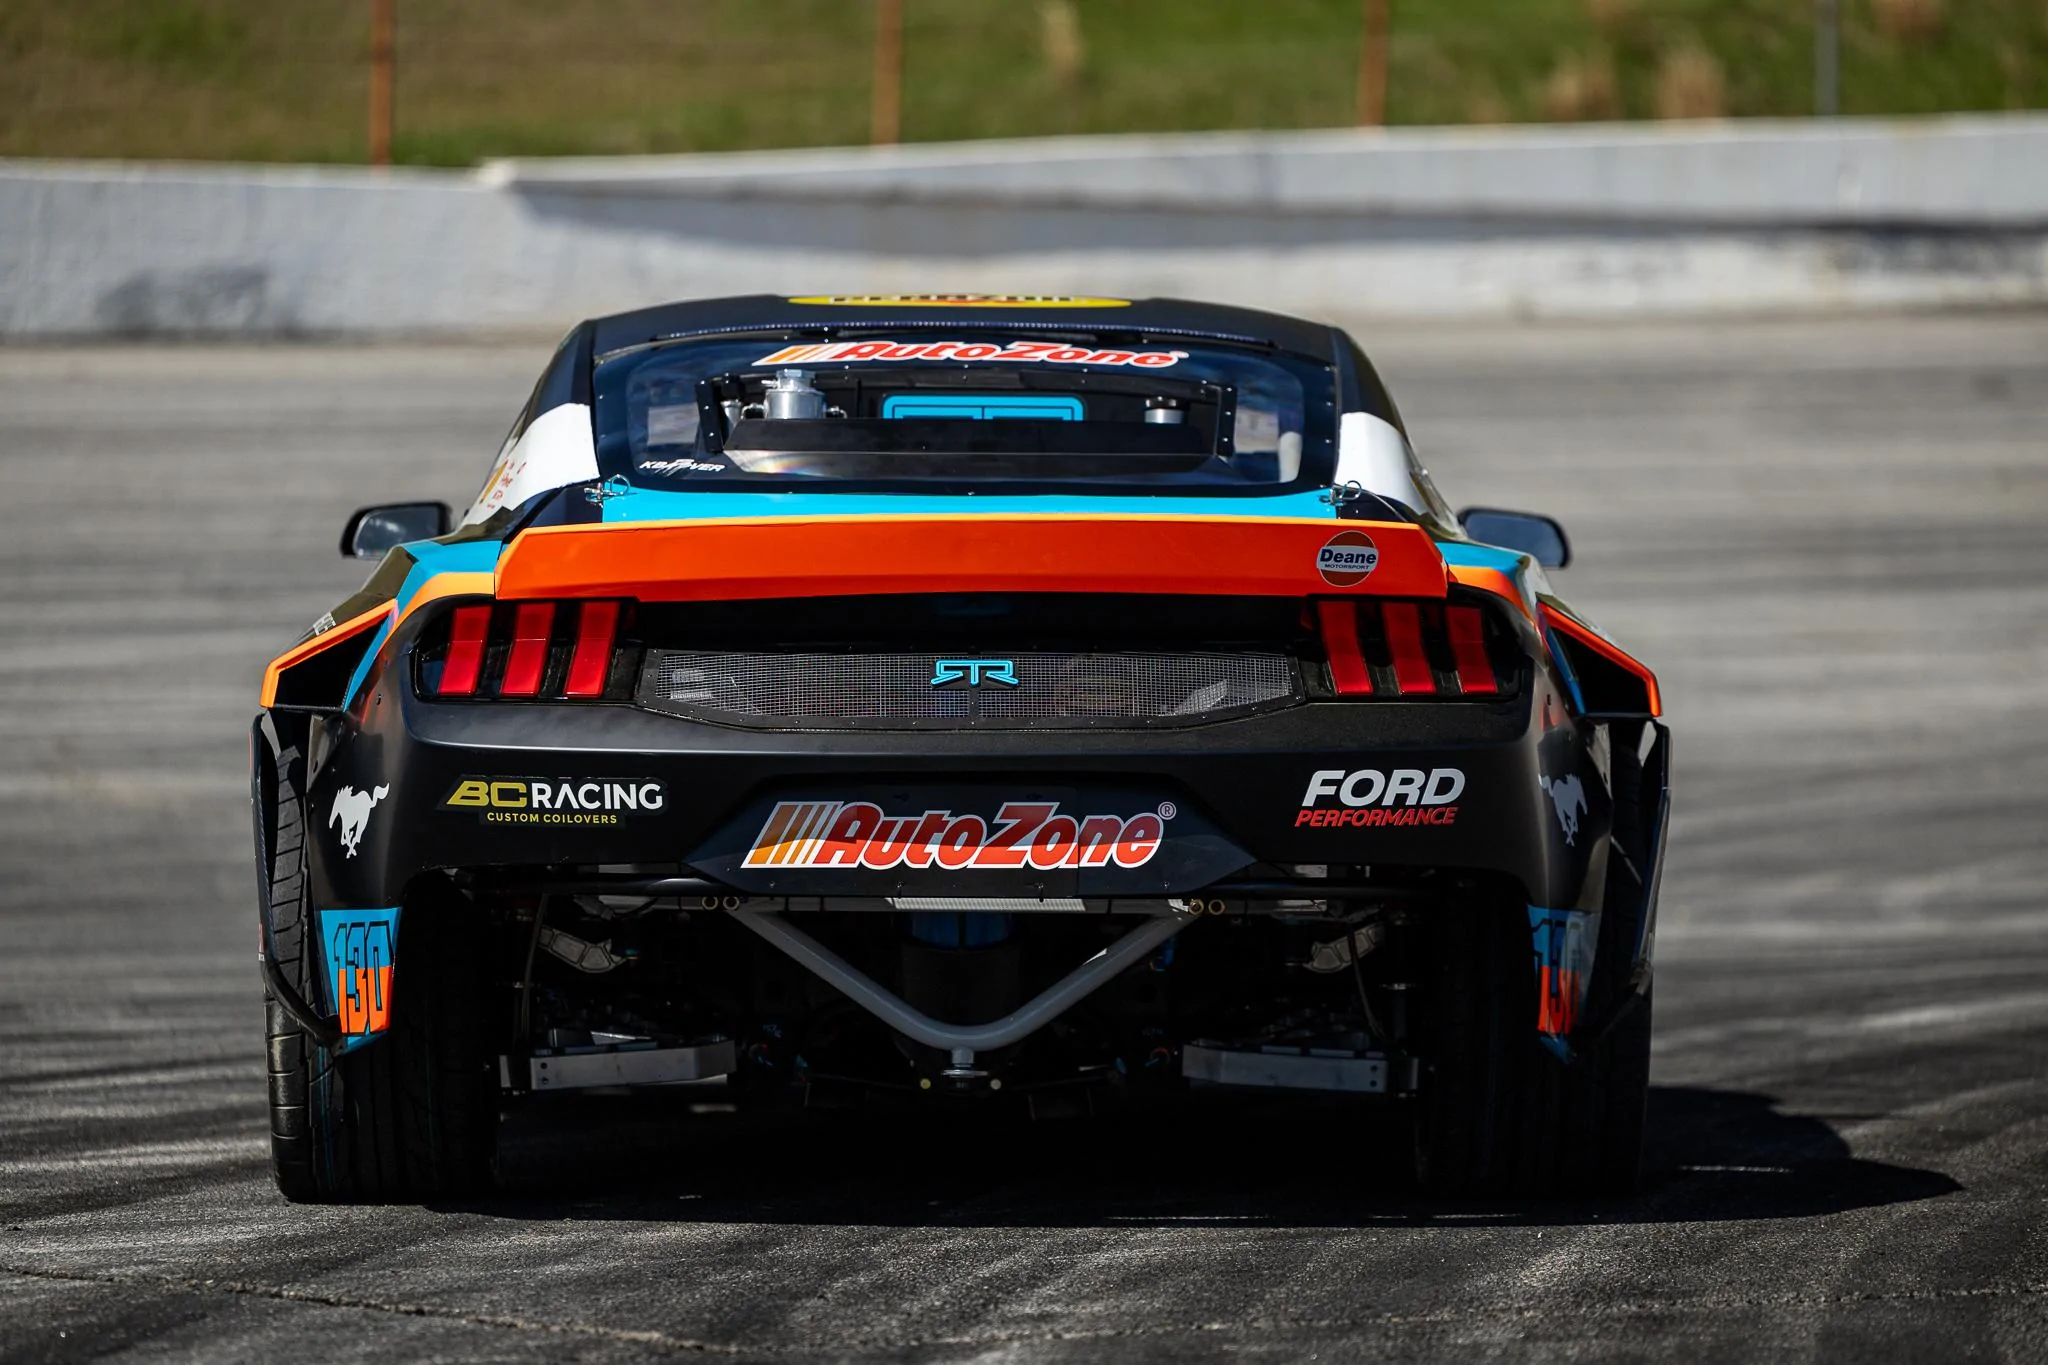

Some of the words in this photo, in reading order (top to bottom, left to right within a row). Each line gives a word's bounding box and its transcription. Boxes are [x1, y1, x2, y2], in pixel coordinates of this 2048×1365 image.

[827, 341, 1179, 368] AutoZone
[1320, 548, 1377, 564] Deane
[1301, 768, 1466, 806] FORD
[487, 812, 539, 823] CUSTOM
[543, 813, 617, 824] COILOVERS
[1294, 806, 1459, 827] PERFORMANCE
[811, 801, 1164, 870] AutoZone
[334, 920, 393, 1036] 130
